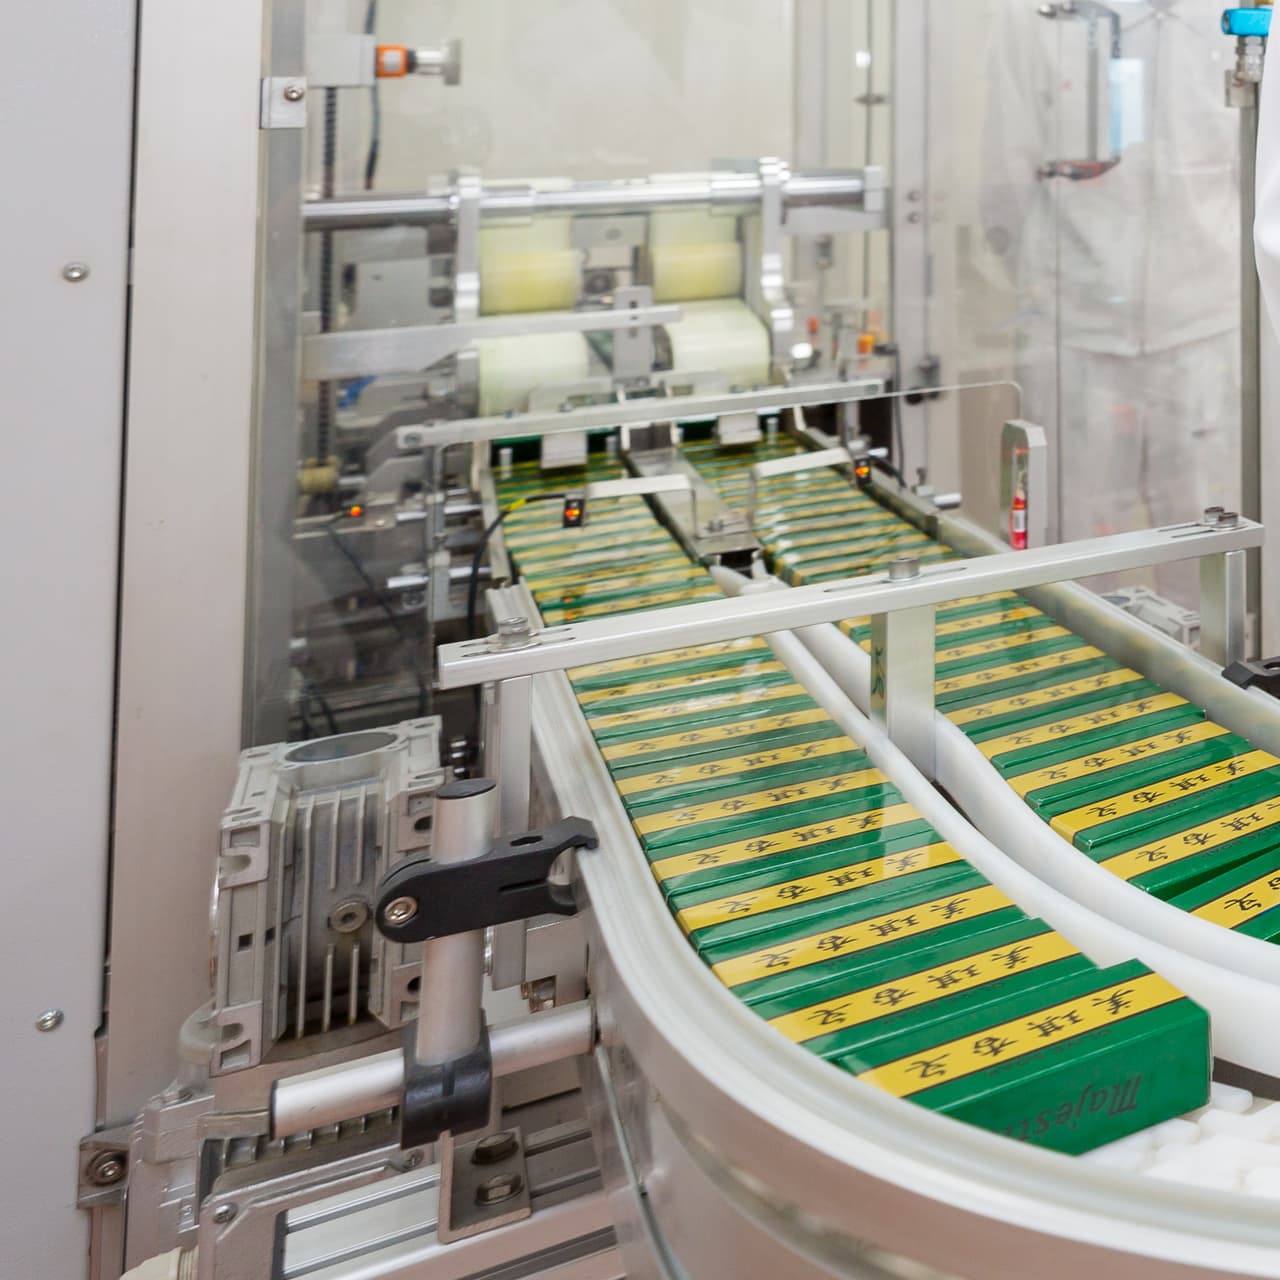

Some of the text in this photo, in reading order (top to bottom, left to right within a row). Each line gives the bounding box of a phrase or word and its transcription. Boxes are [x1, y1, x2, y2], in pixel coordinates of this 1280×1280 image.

[1088, 759, 1246, 818] 美琪香皂
[806, 945, 1033, 1026] 美琪香皂
[905, 989, 1135, 1079] 美琪香皂
[1003, 1072, 1142, 1143] Majesti
